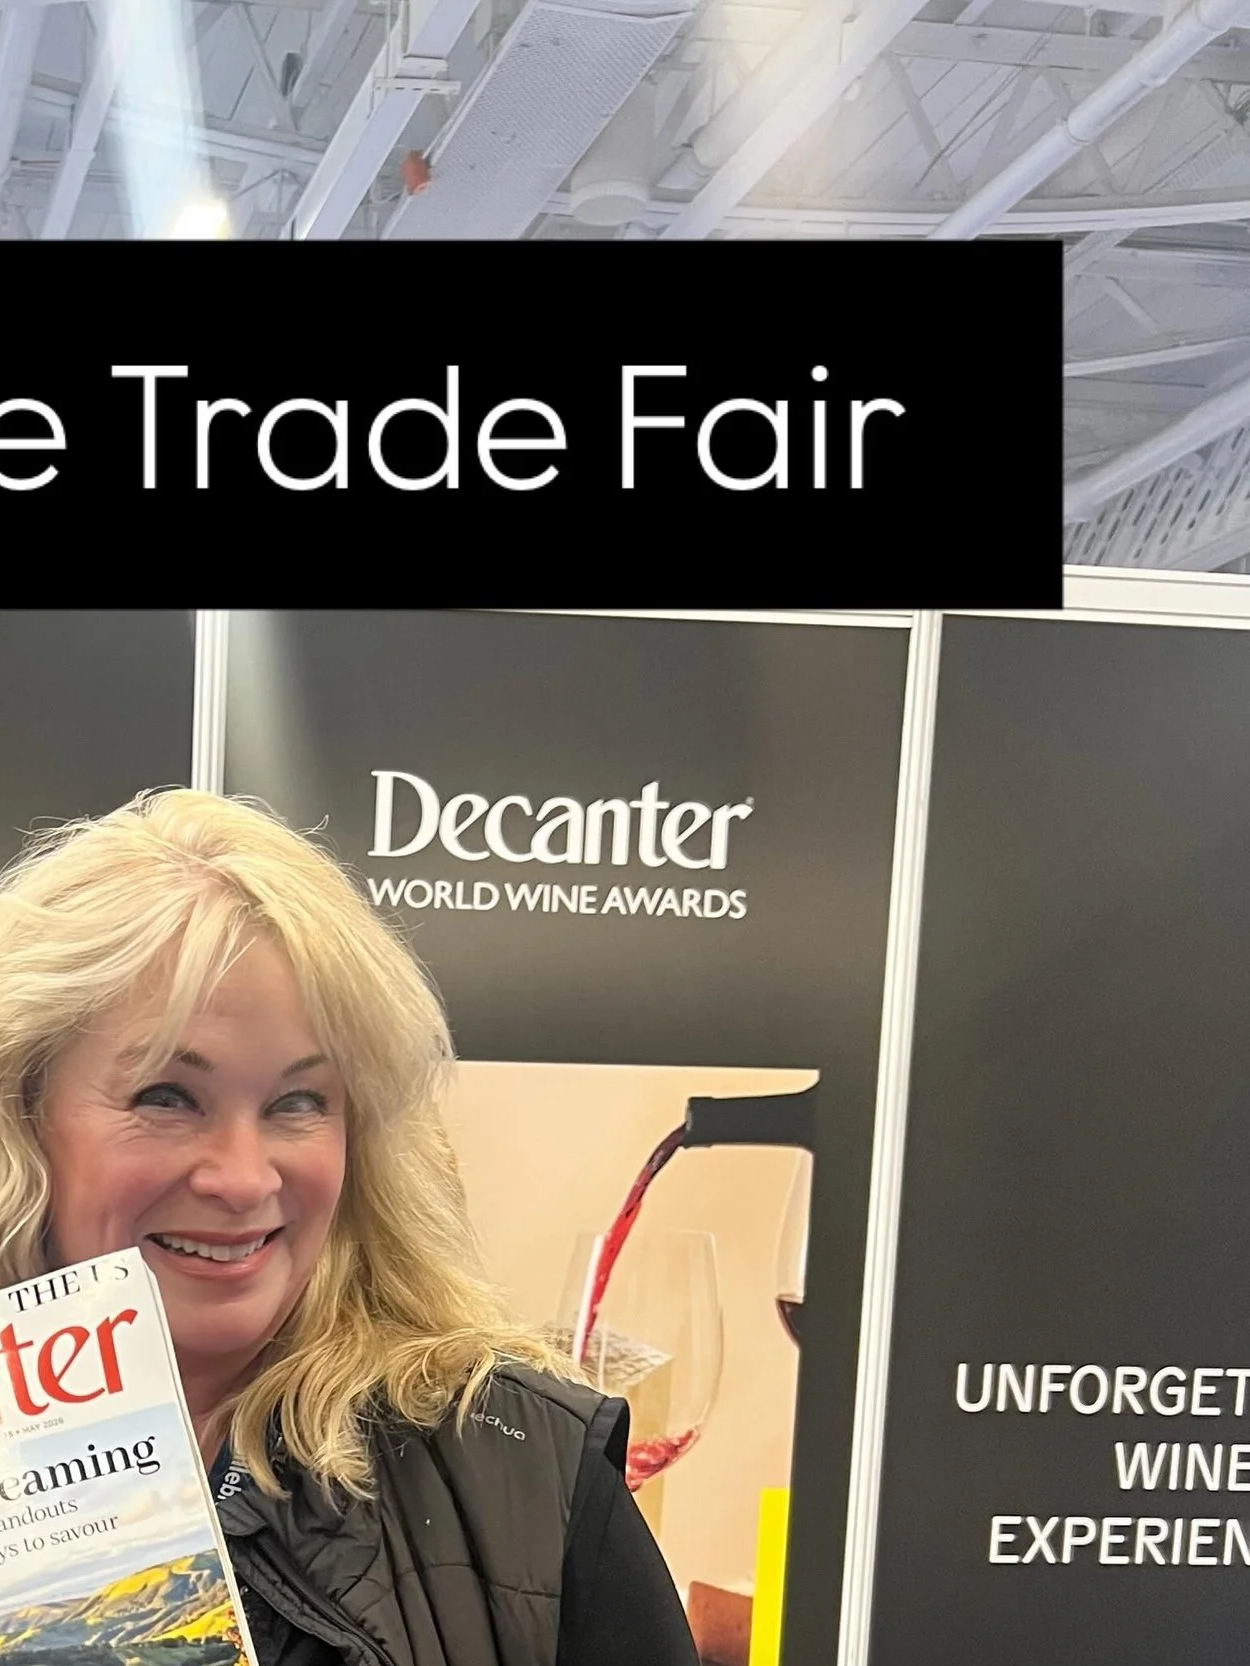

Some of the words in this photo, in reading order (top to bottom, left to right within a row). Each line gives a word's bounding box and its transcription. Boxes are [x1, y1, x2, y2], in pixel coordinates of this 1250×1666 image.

[368, 770, 753, 869] Decanter
[368, 878, 499, 911] WORLD
[505, 883, 598, 914] WINE
[601, 886, 747, 919] AWARDS
[8, 1270, 82, 1313] THE
[956, 1362, 1250, 1416] UNFORGET
[453, 1401, 526, 1441] echua
[1115, 1441, 1250, 1491] WINE
[24, 1533, 45, 1553] to
[50, 1515, 119, 1545] savour
[989, 1515, 1250, 1566] EXPERIEN
